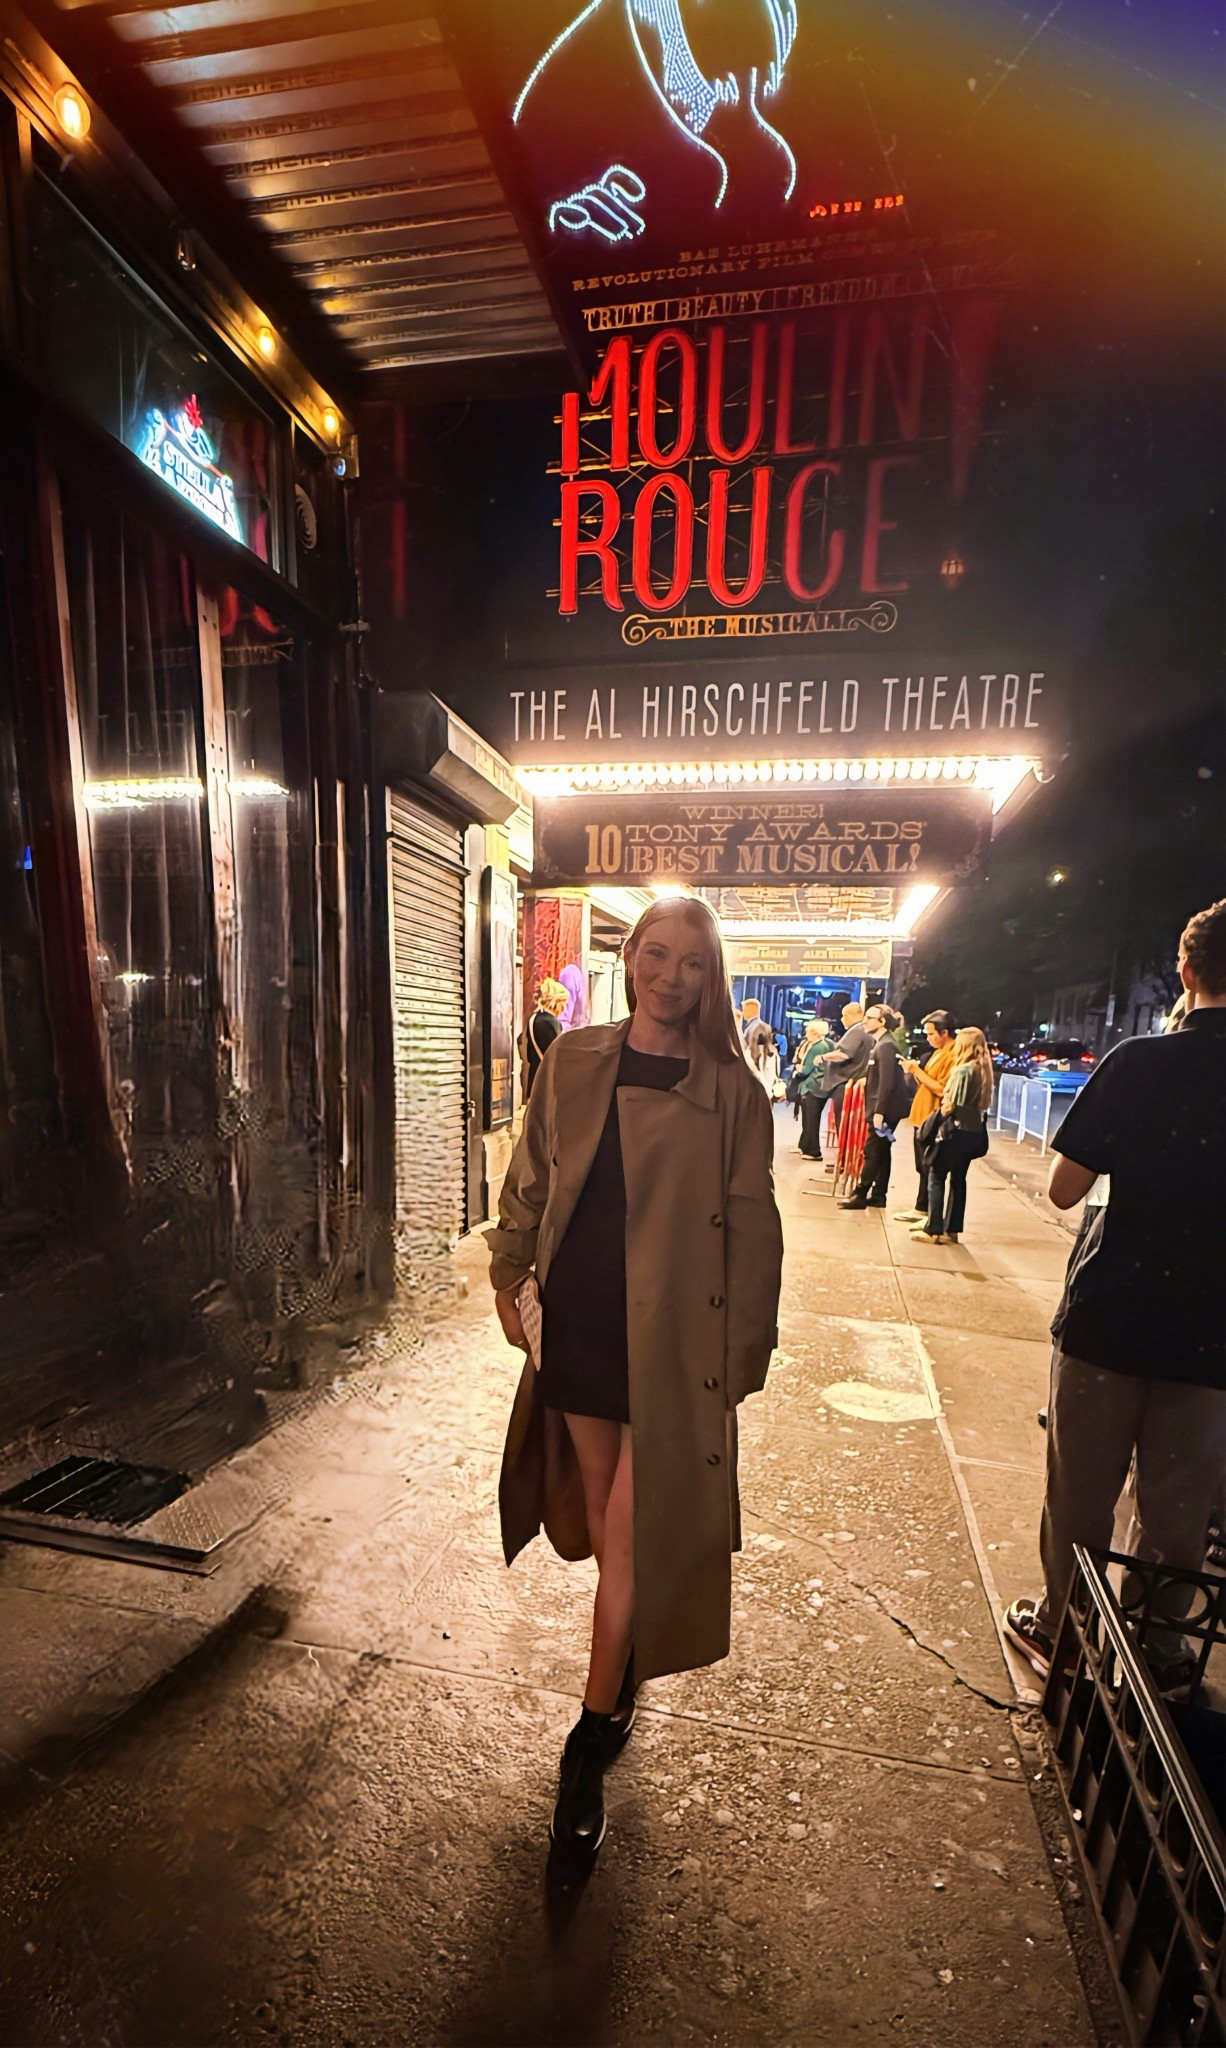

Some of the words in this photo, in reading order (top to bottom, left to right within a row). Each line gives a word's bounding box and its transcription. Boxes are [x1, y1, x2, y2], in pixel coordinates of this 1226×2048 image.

[571, 258, 751, 292] REVOLUTIONARY
[757, 252, 815, 270] FILM
[678, 246, 720, 263] BAS
[581, 303, 656, 332] TRUTH
[677, 289, 765, 322] BEAUTY
[669, 614, 715, 640] THE
[510, 689, 567, 742] THE
[585, 687, 622, 740] AL
[642, 679, 859, 738] HIRSCHFELD
[882, 672, 1045, 732] THEATRE
[679, 803, 825, 820] WINNER!
[584, 823, 623, 874] 10
[625, 823, 735, 843] TONY
[744, 821, 924, 842] AWARDS
[629, 844, 724, 874] BEST
[735, 842, 921, 874] MUSICAL!
